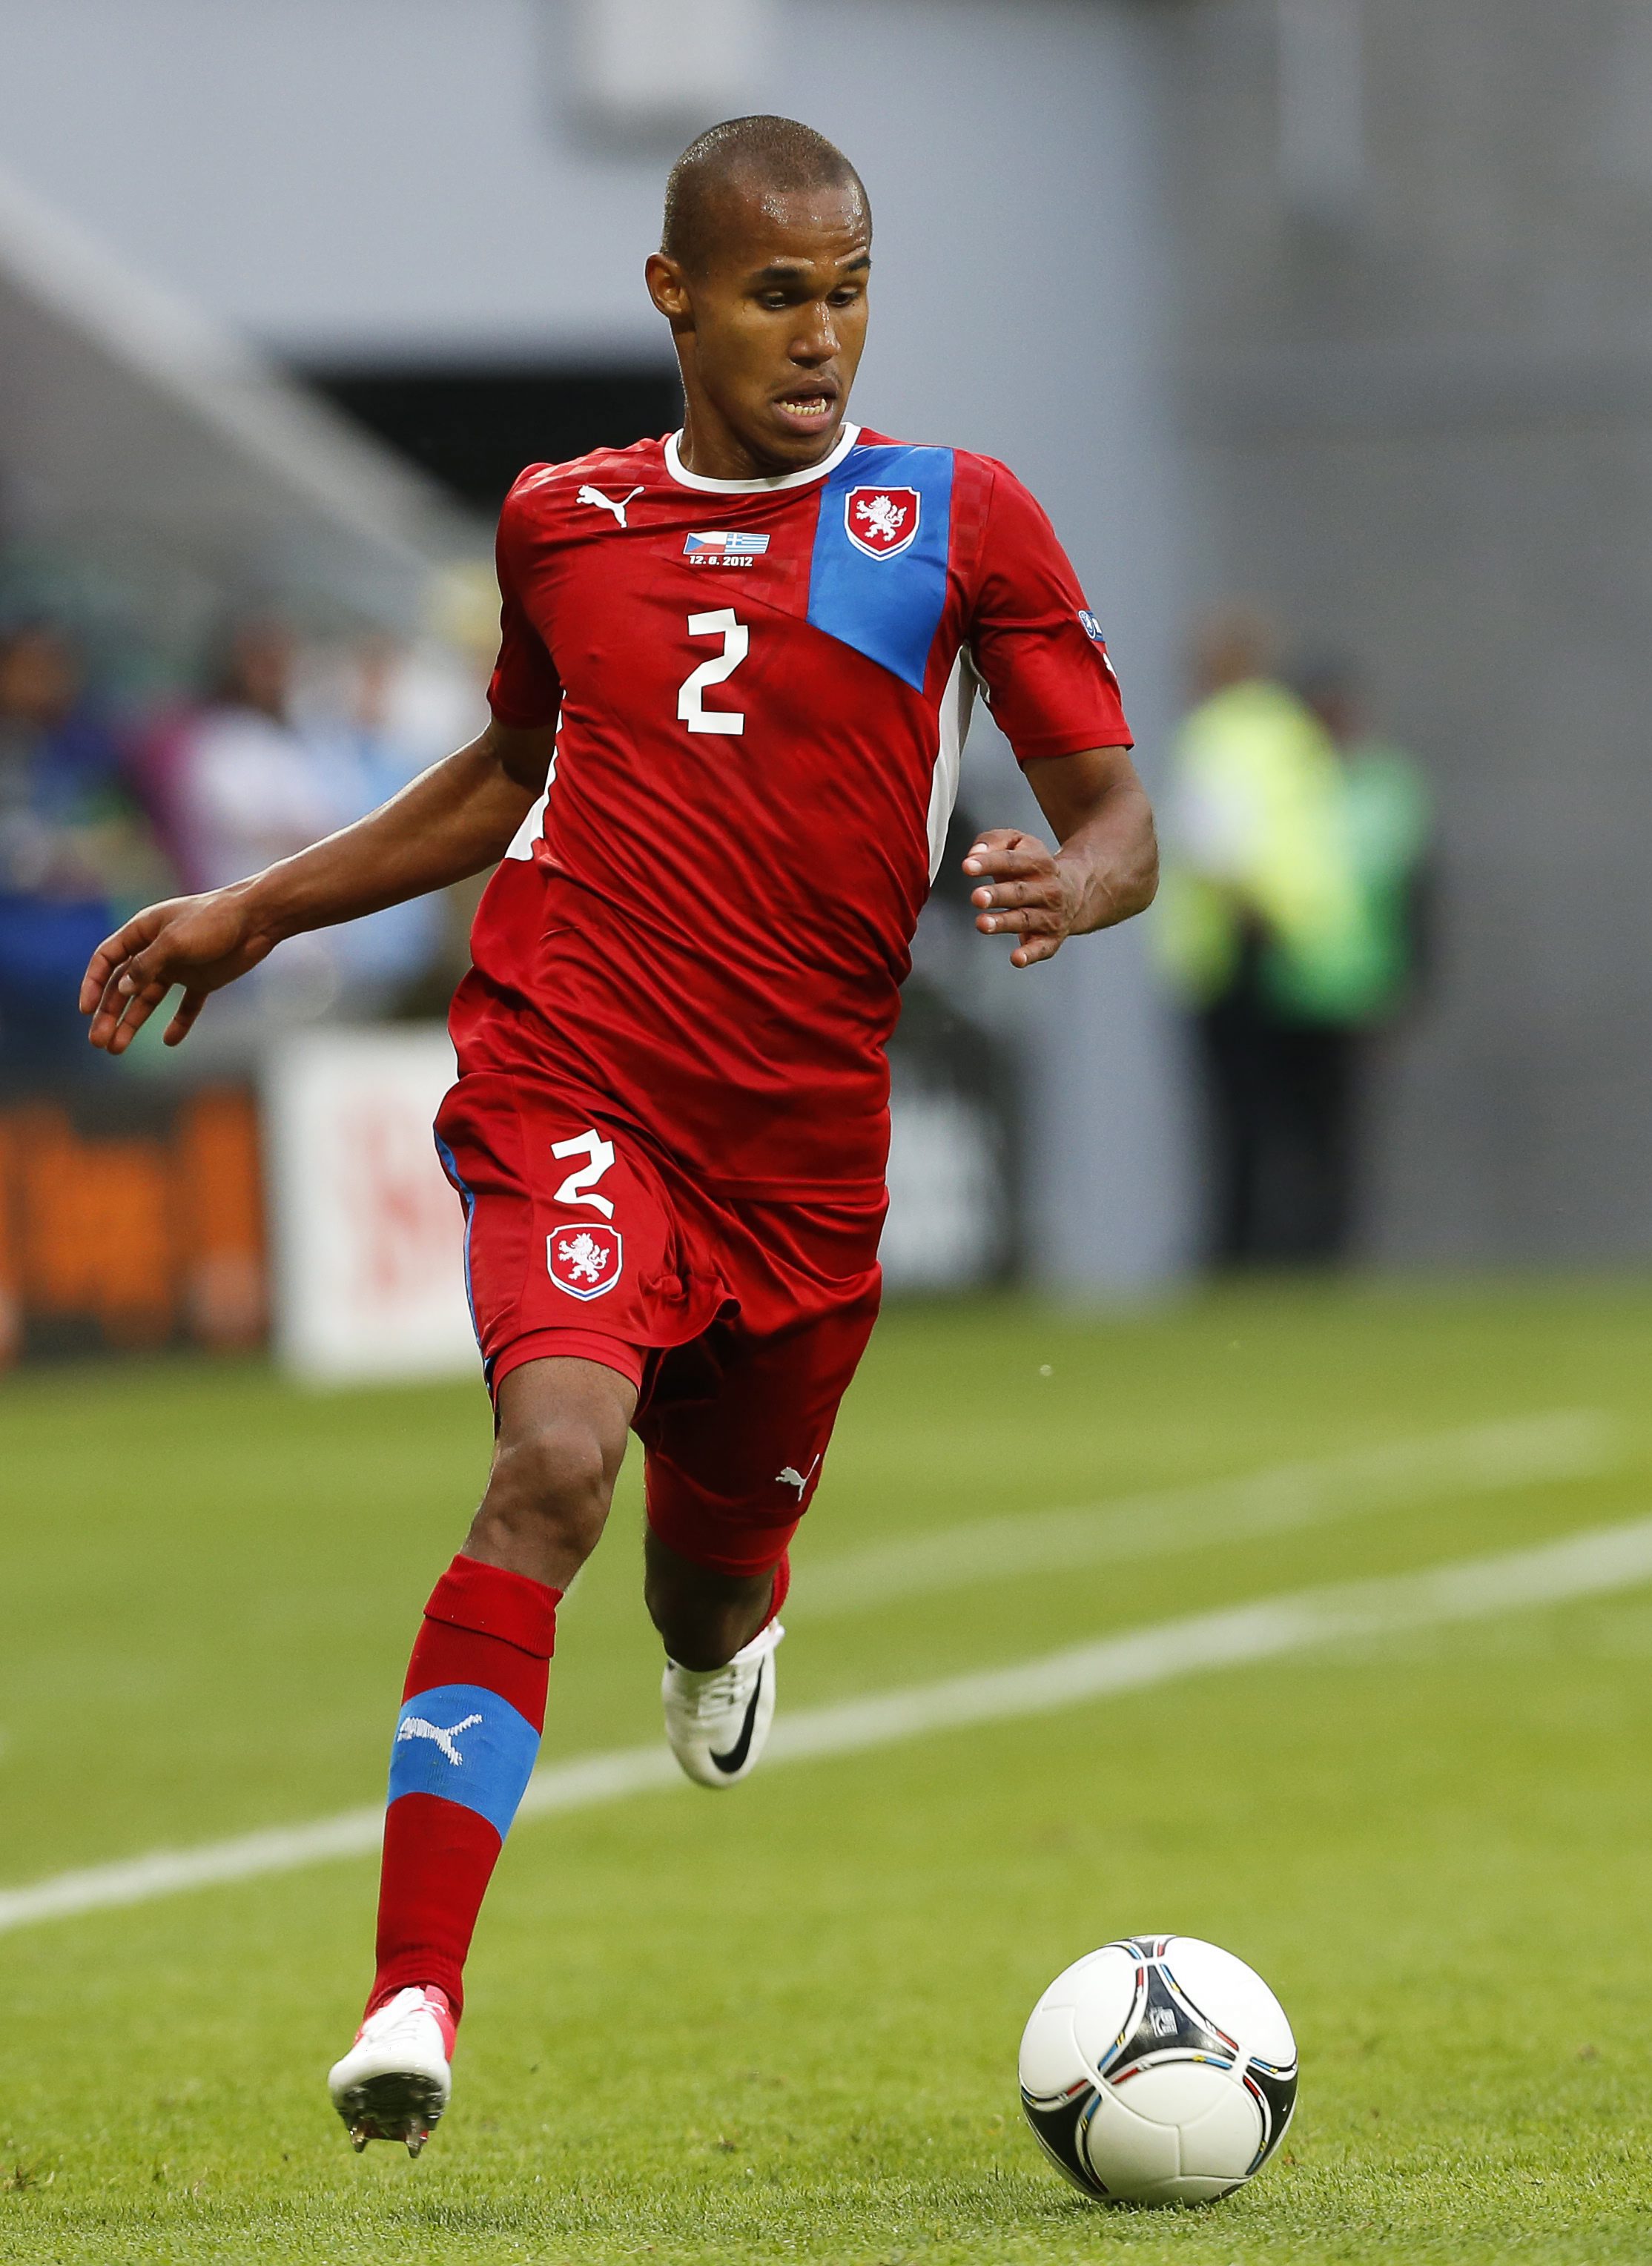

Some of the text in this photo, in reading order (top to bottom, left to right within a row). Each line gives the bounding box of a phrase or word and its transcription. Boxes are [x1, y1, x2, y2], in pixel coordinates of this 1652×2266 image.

[722, 556, 753, 566] 2012
[677, 607, 748, 735] 2
[550, 1128, 615, 1220] 2
